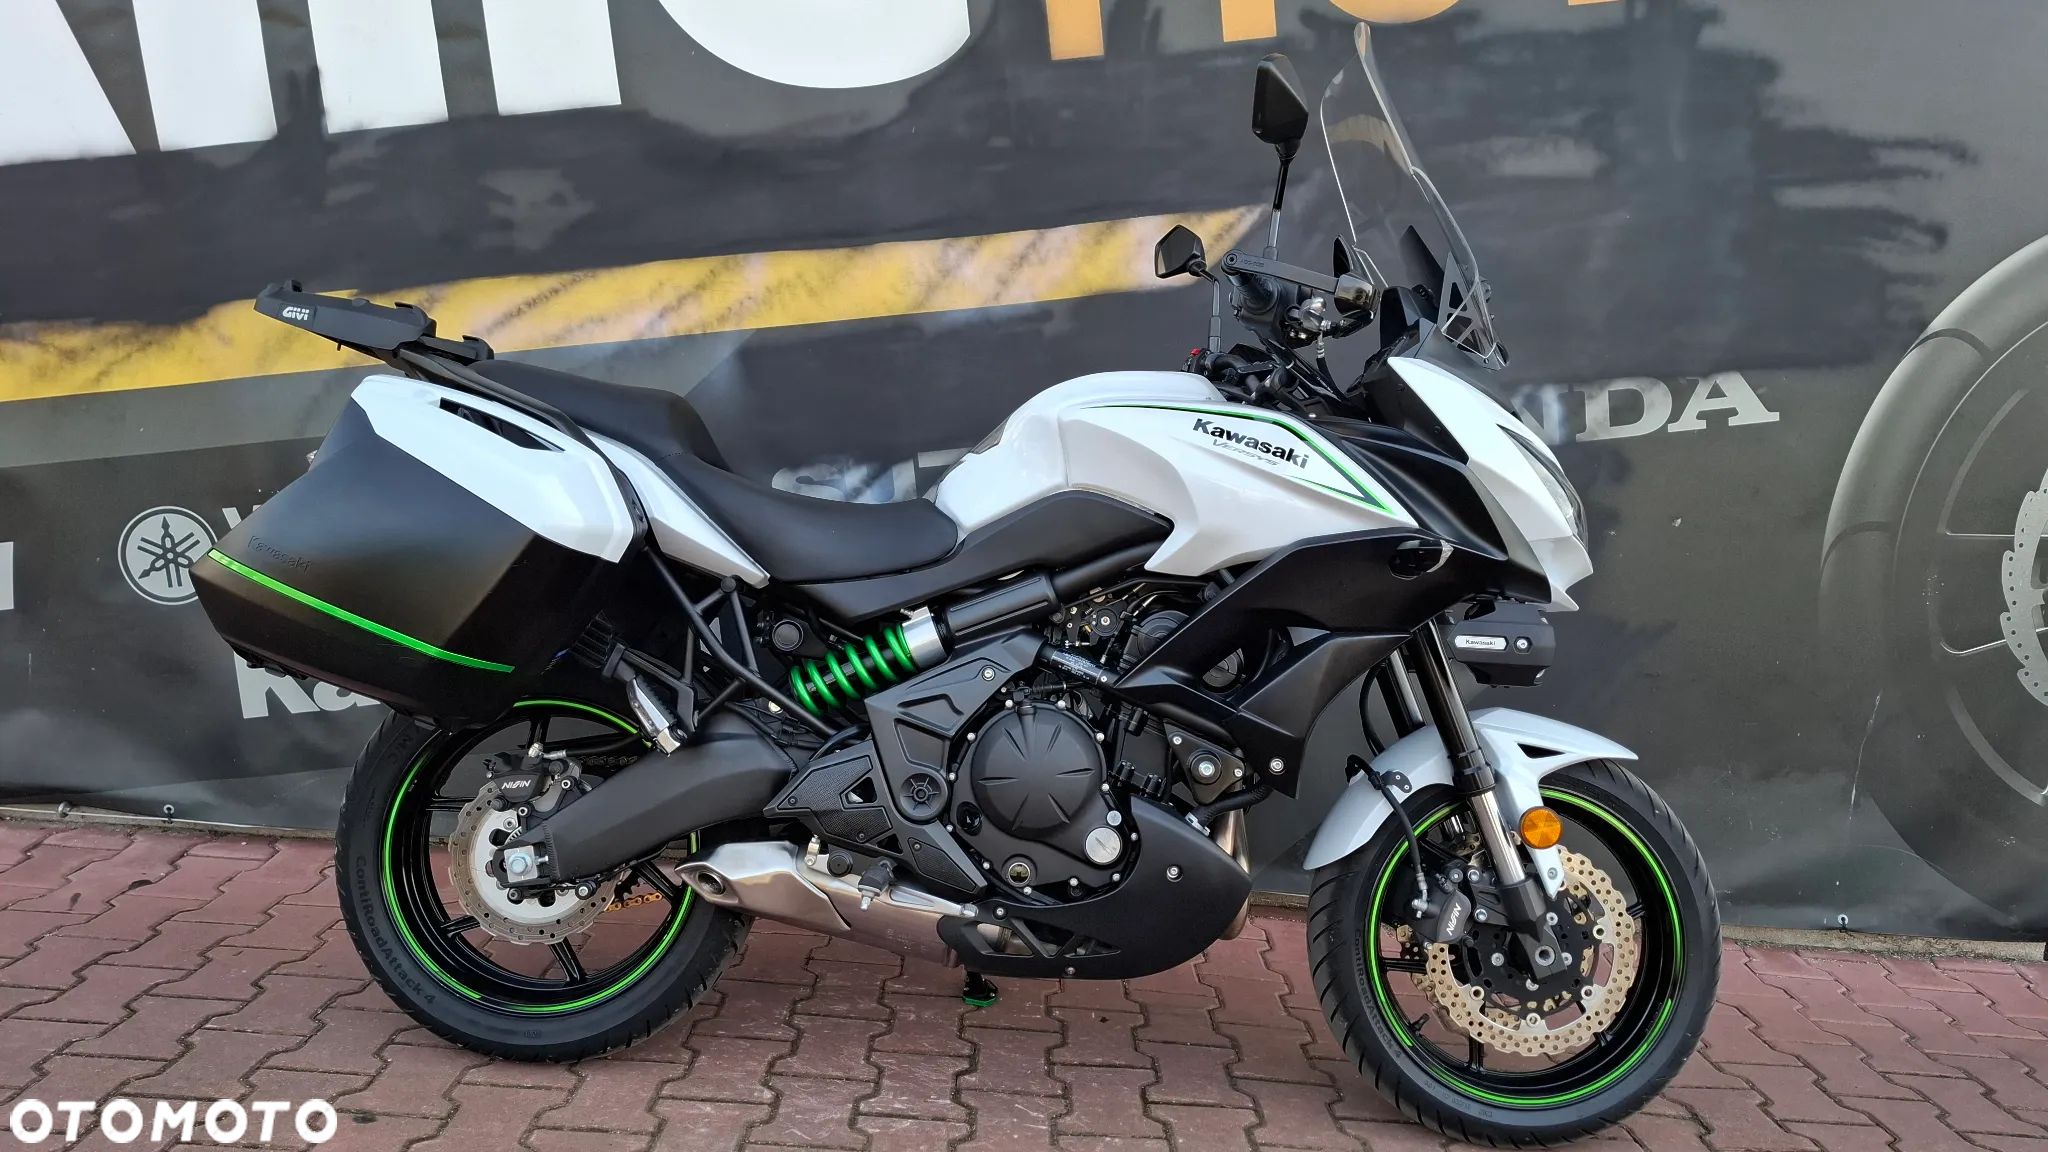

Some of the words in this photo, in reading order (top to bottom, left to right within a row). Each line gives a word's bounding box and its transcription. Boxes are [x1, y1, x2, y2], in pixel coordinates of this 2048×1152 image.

[1192, 418, 1310, 470] Kawasaki
[247, 535, 312, 577] Kawasaki
[1465, 638, 1496, 646] Kawasaki
[354, 855, 424, 996] ContiRoadAttack
[424, 994, 436, 1004] 4
